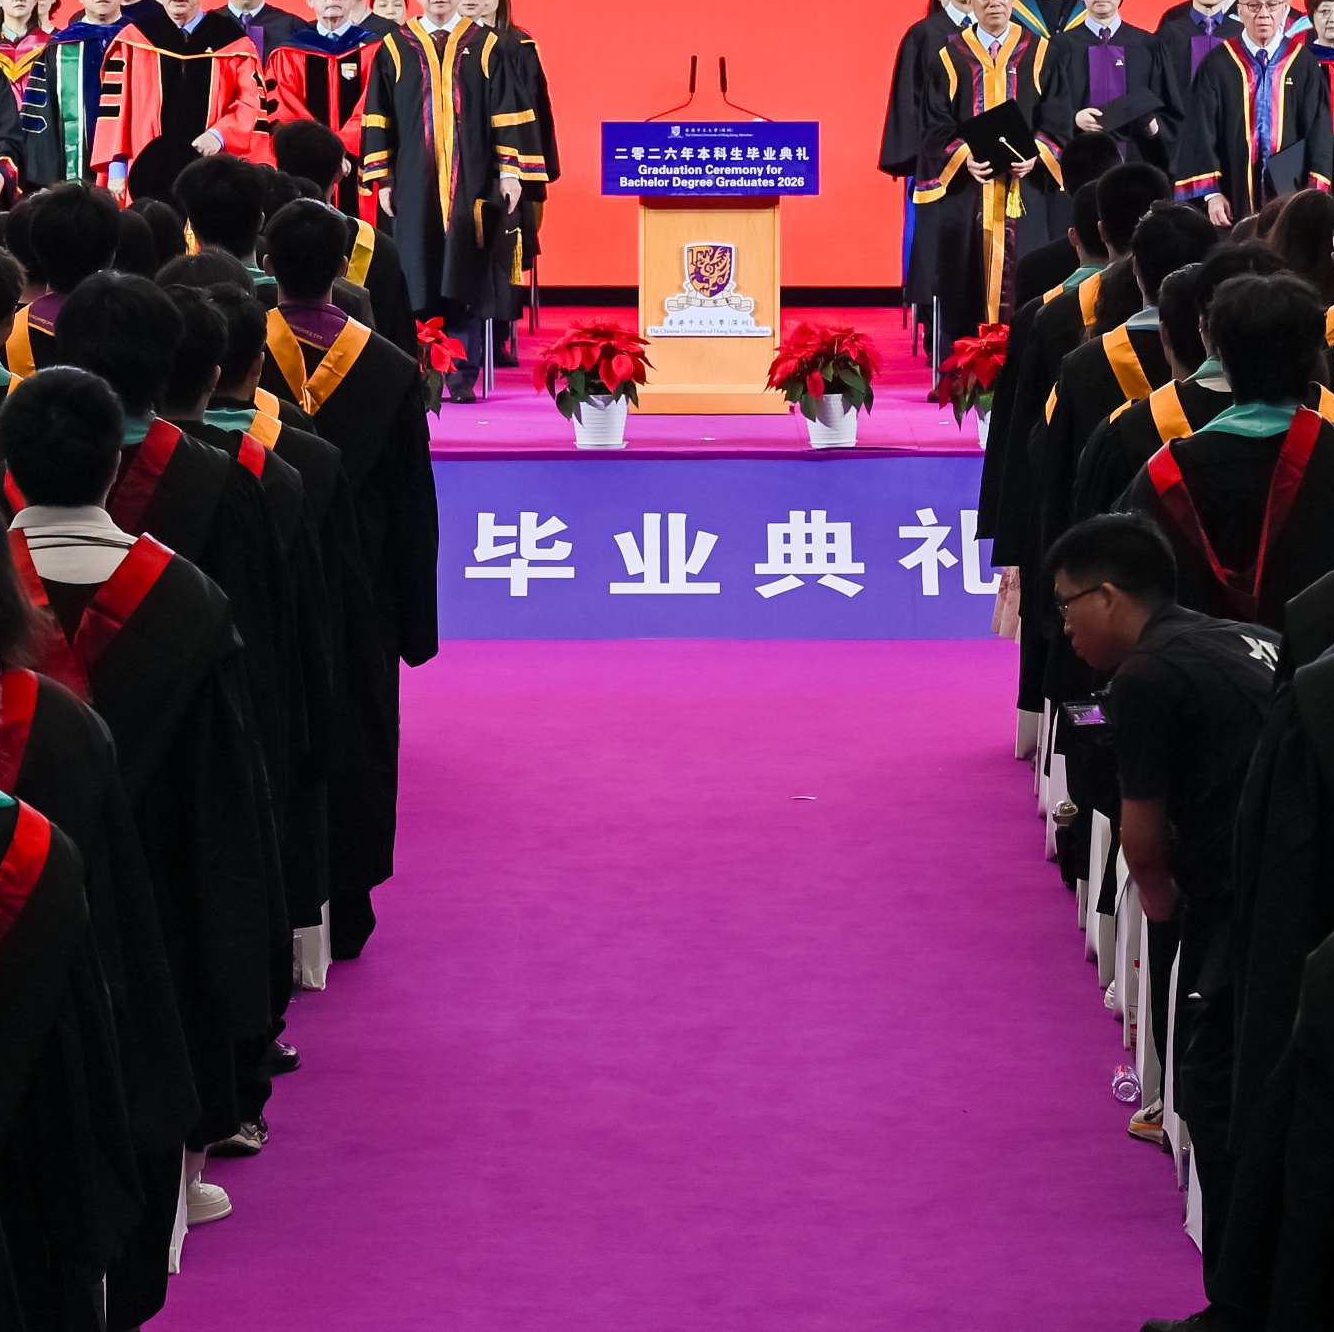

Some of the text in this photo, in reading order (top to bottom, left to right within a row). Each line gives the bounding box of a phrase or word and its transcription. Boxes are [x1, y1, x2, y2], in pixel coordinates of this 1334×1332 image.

[615, 147, 810, 161] 二零二六年本科生毕业典礼
[638, 164, 783, 177] Graduation Ceremony for
[619, 177, 805, 189] Bachelor Degree Graduates 2026
[464, 507, 1002, 599] 毕业典礼
